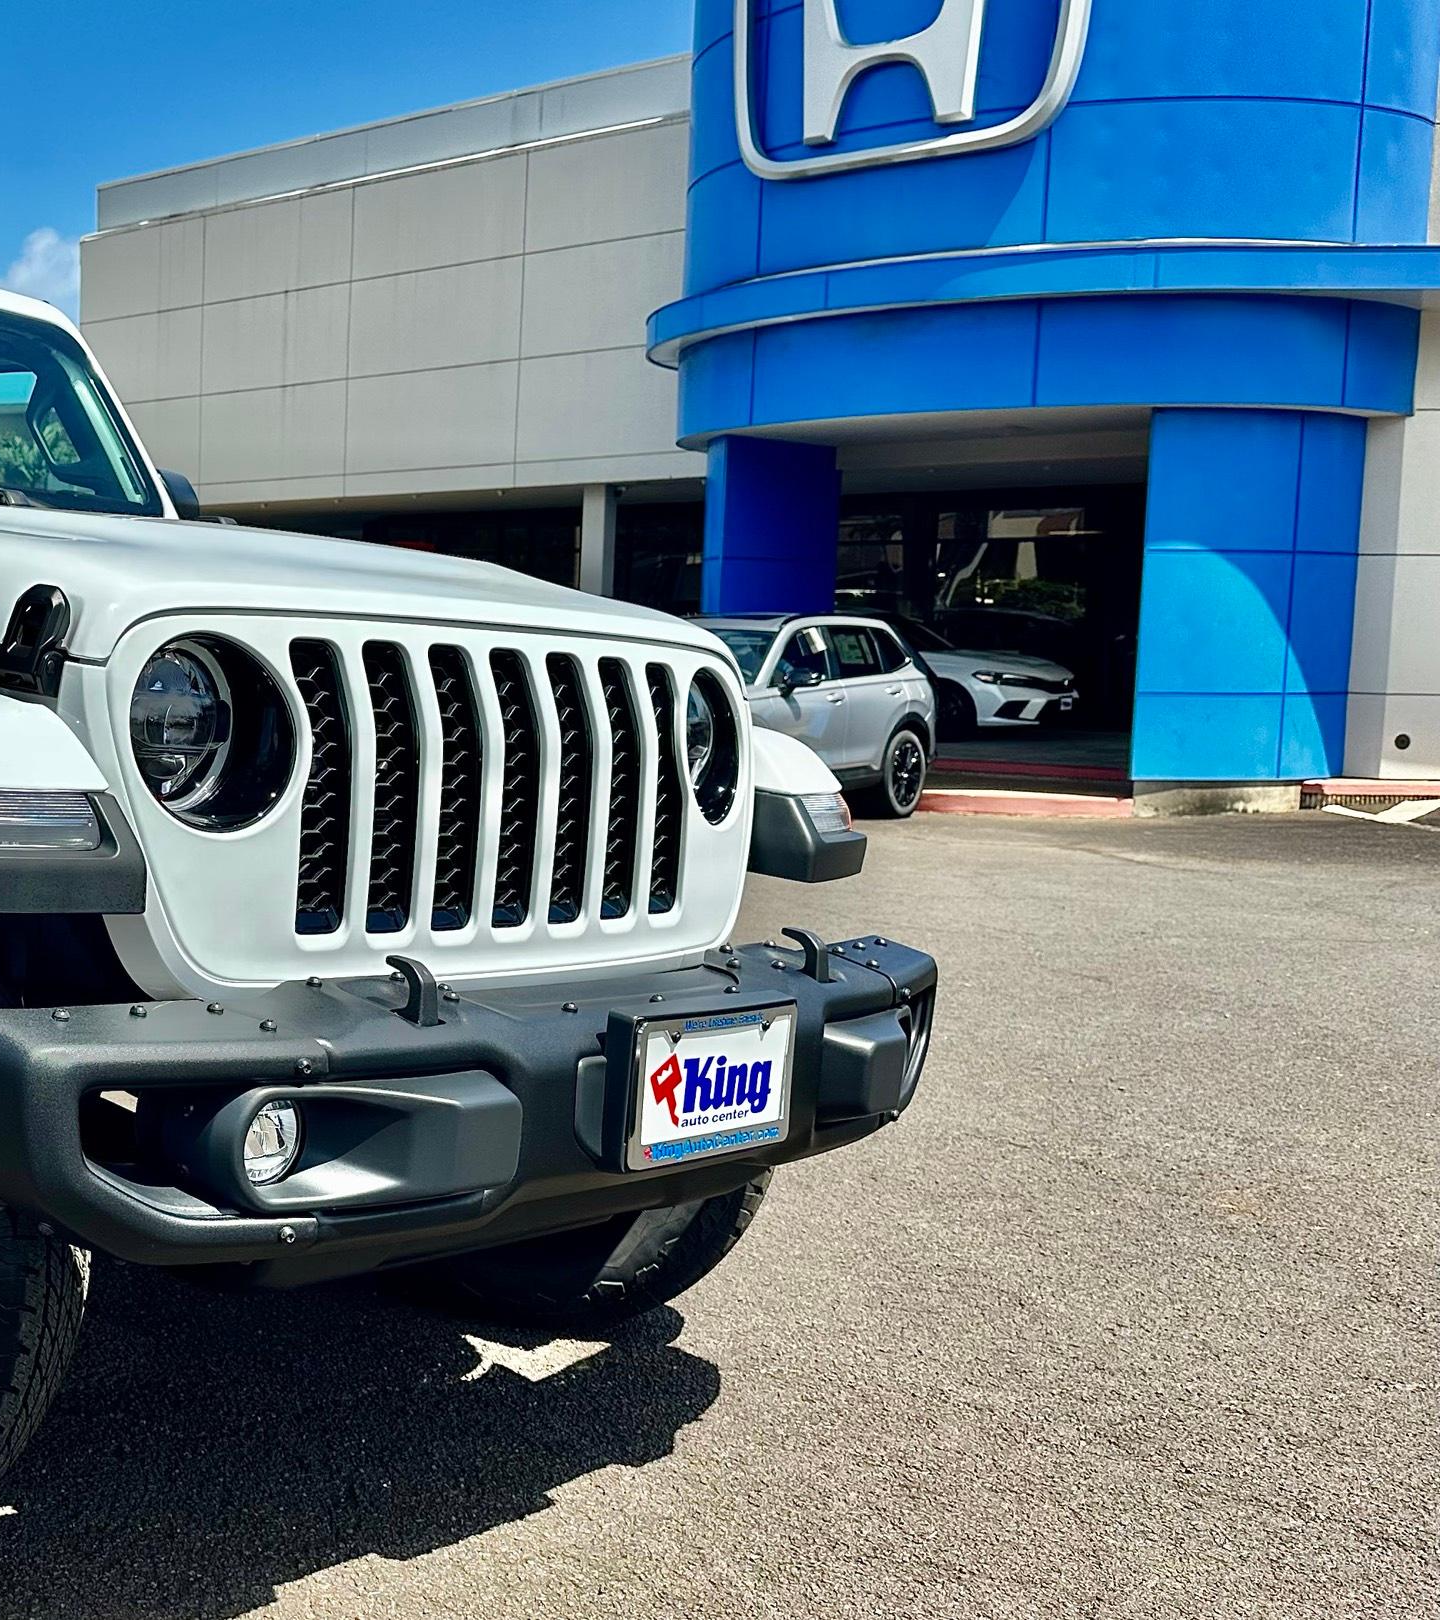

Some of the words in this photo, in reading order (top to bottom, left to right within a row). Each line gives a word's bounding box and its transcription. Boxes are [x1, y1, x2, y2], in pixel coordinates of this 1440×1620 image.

[682, 1055, 772, 1114] King
[681, 1115, 709, 1127] auto
[712, 1109, 749, 1123] center
[651, 1127, 779, 1161] KingAutoCenter.com
